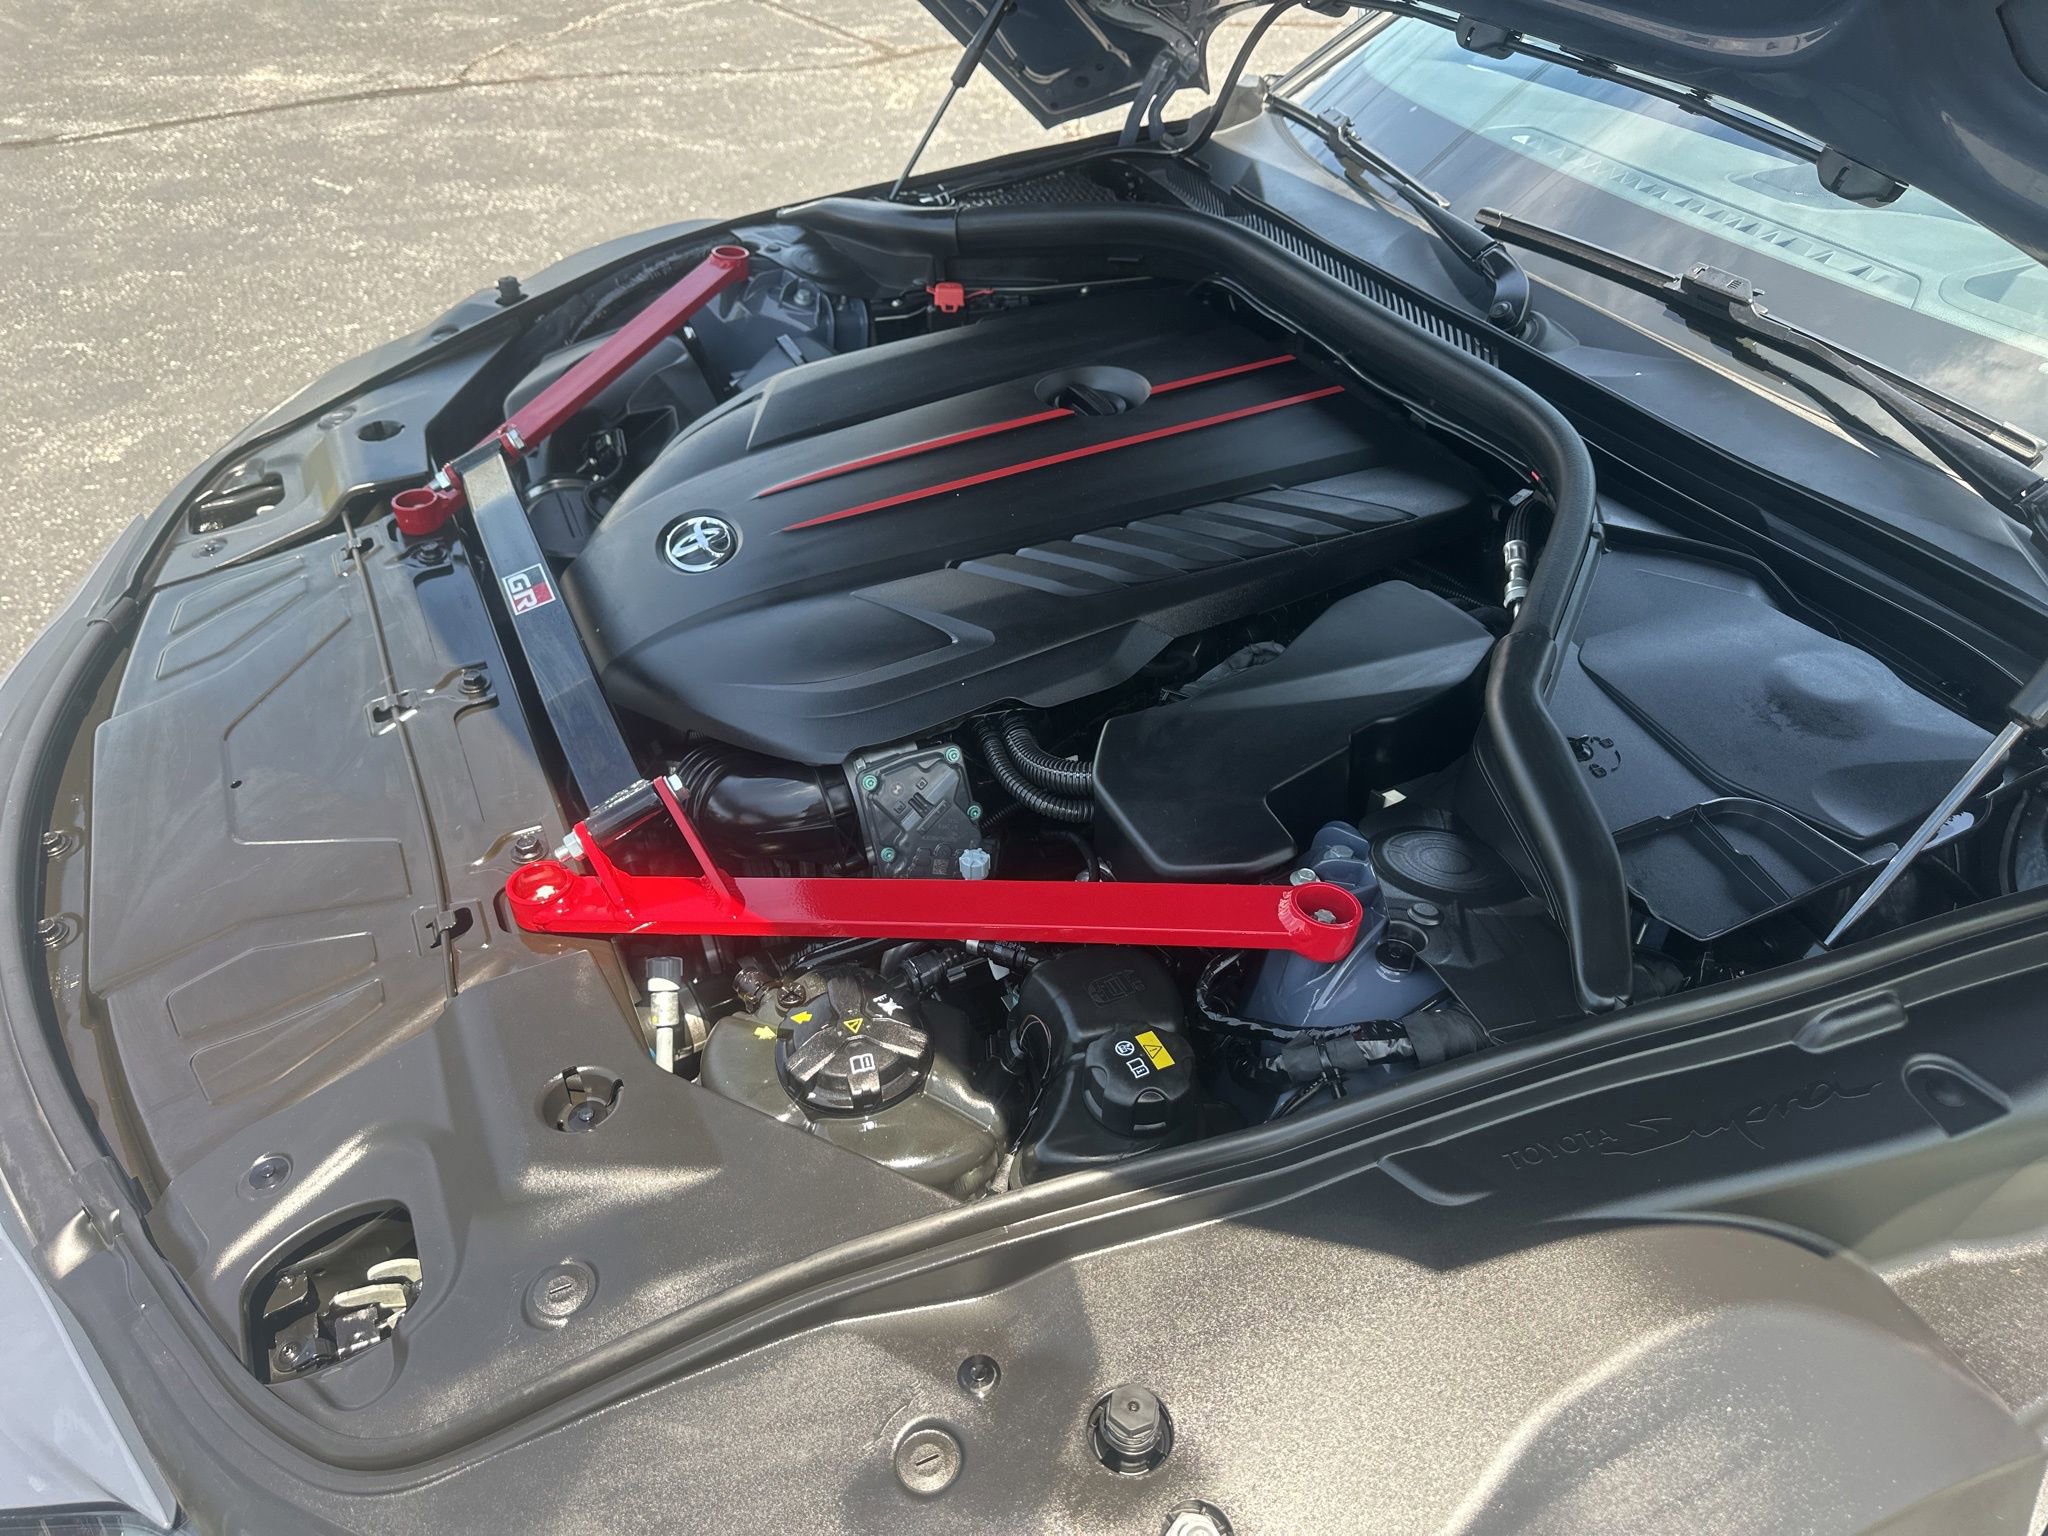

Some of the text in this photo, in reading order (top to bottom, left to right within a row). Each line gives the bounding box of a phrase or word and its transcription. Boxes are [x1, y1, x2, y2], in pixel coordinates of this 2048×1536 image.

[507, 573, 538, 611] GR
[1501, 1080, 1884, 1170] TOYOTA Supra
